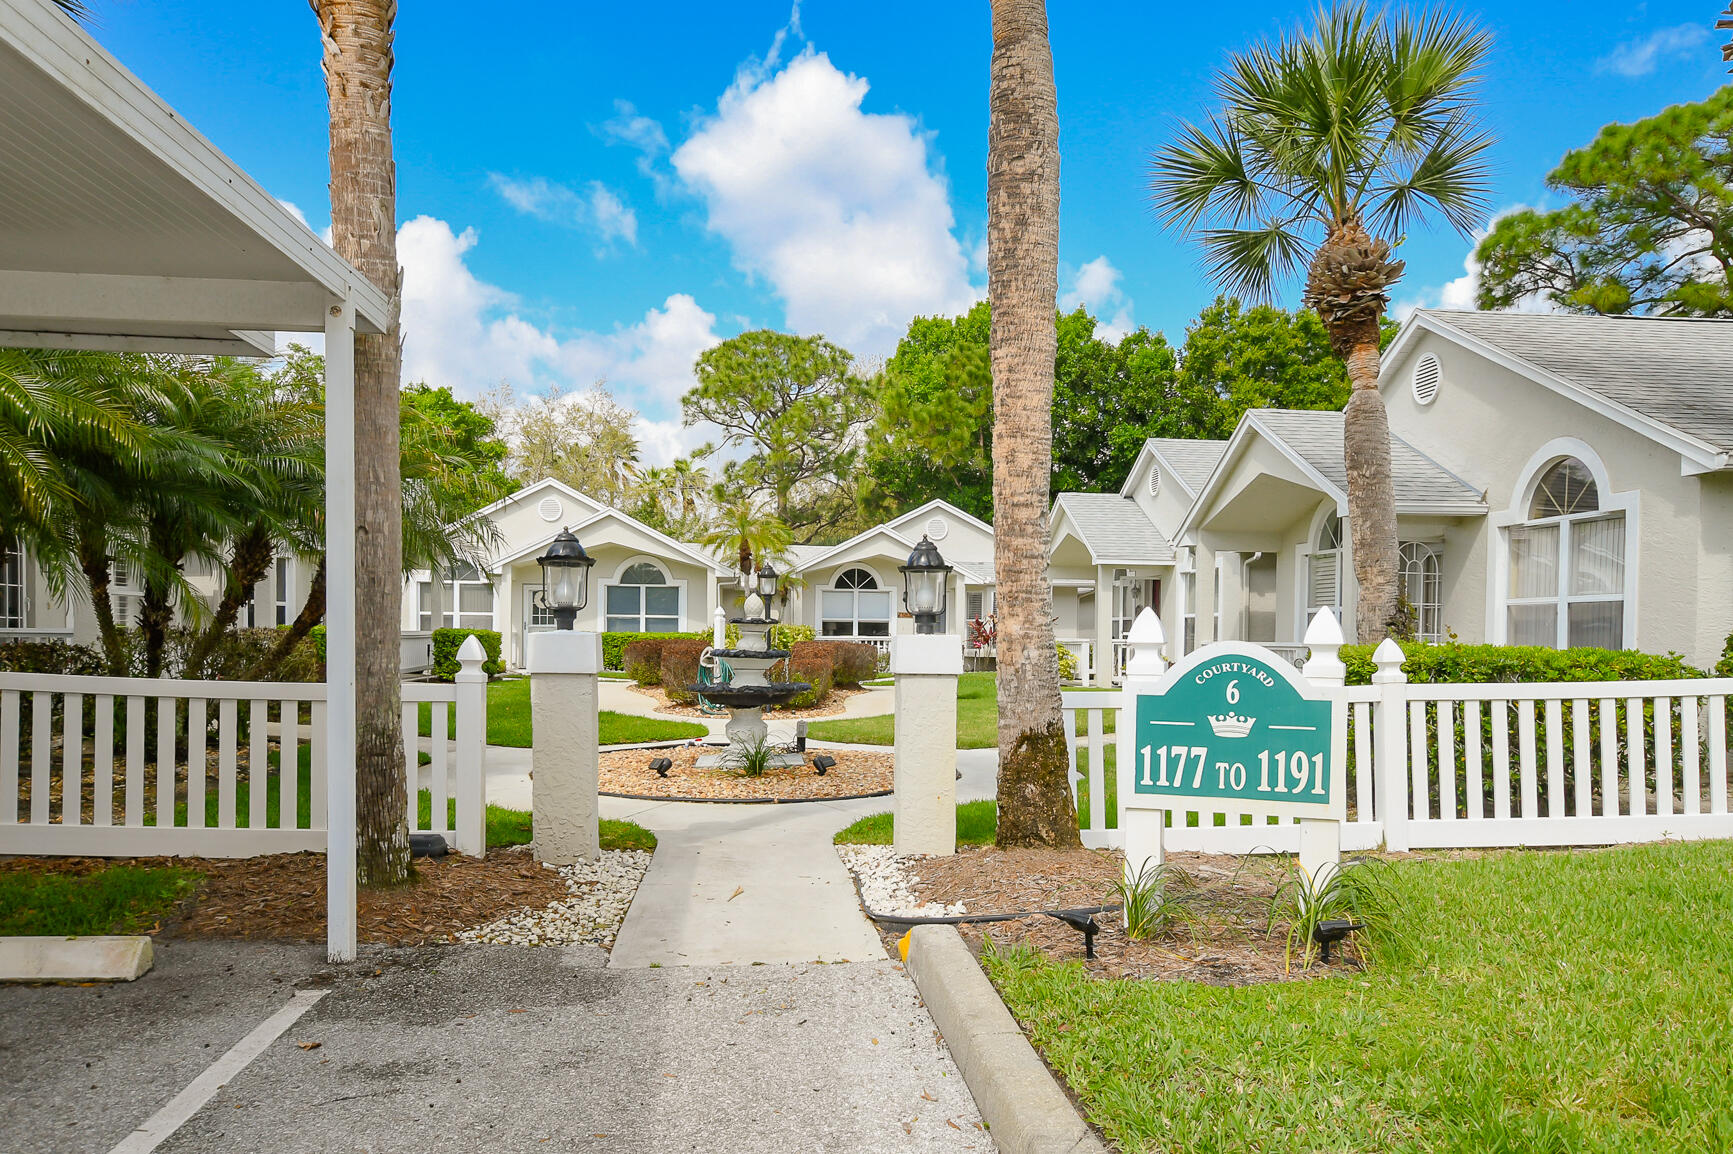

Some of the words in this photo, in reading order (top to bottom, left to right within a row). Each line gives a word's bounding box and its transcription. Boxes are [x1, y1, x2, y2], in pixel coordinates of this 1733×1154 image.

[1195, 662, 1275, 687] COURTYARD
[1225, 679, 1240, 704] 6
[1140, 744, 1208, 789] 1177
[1215, 762, 1247, 791] TO
[1257, 749, 1326, 795] 1191
